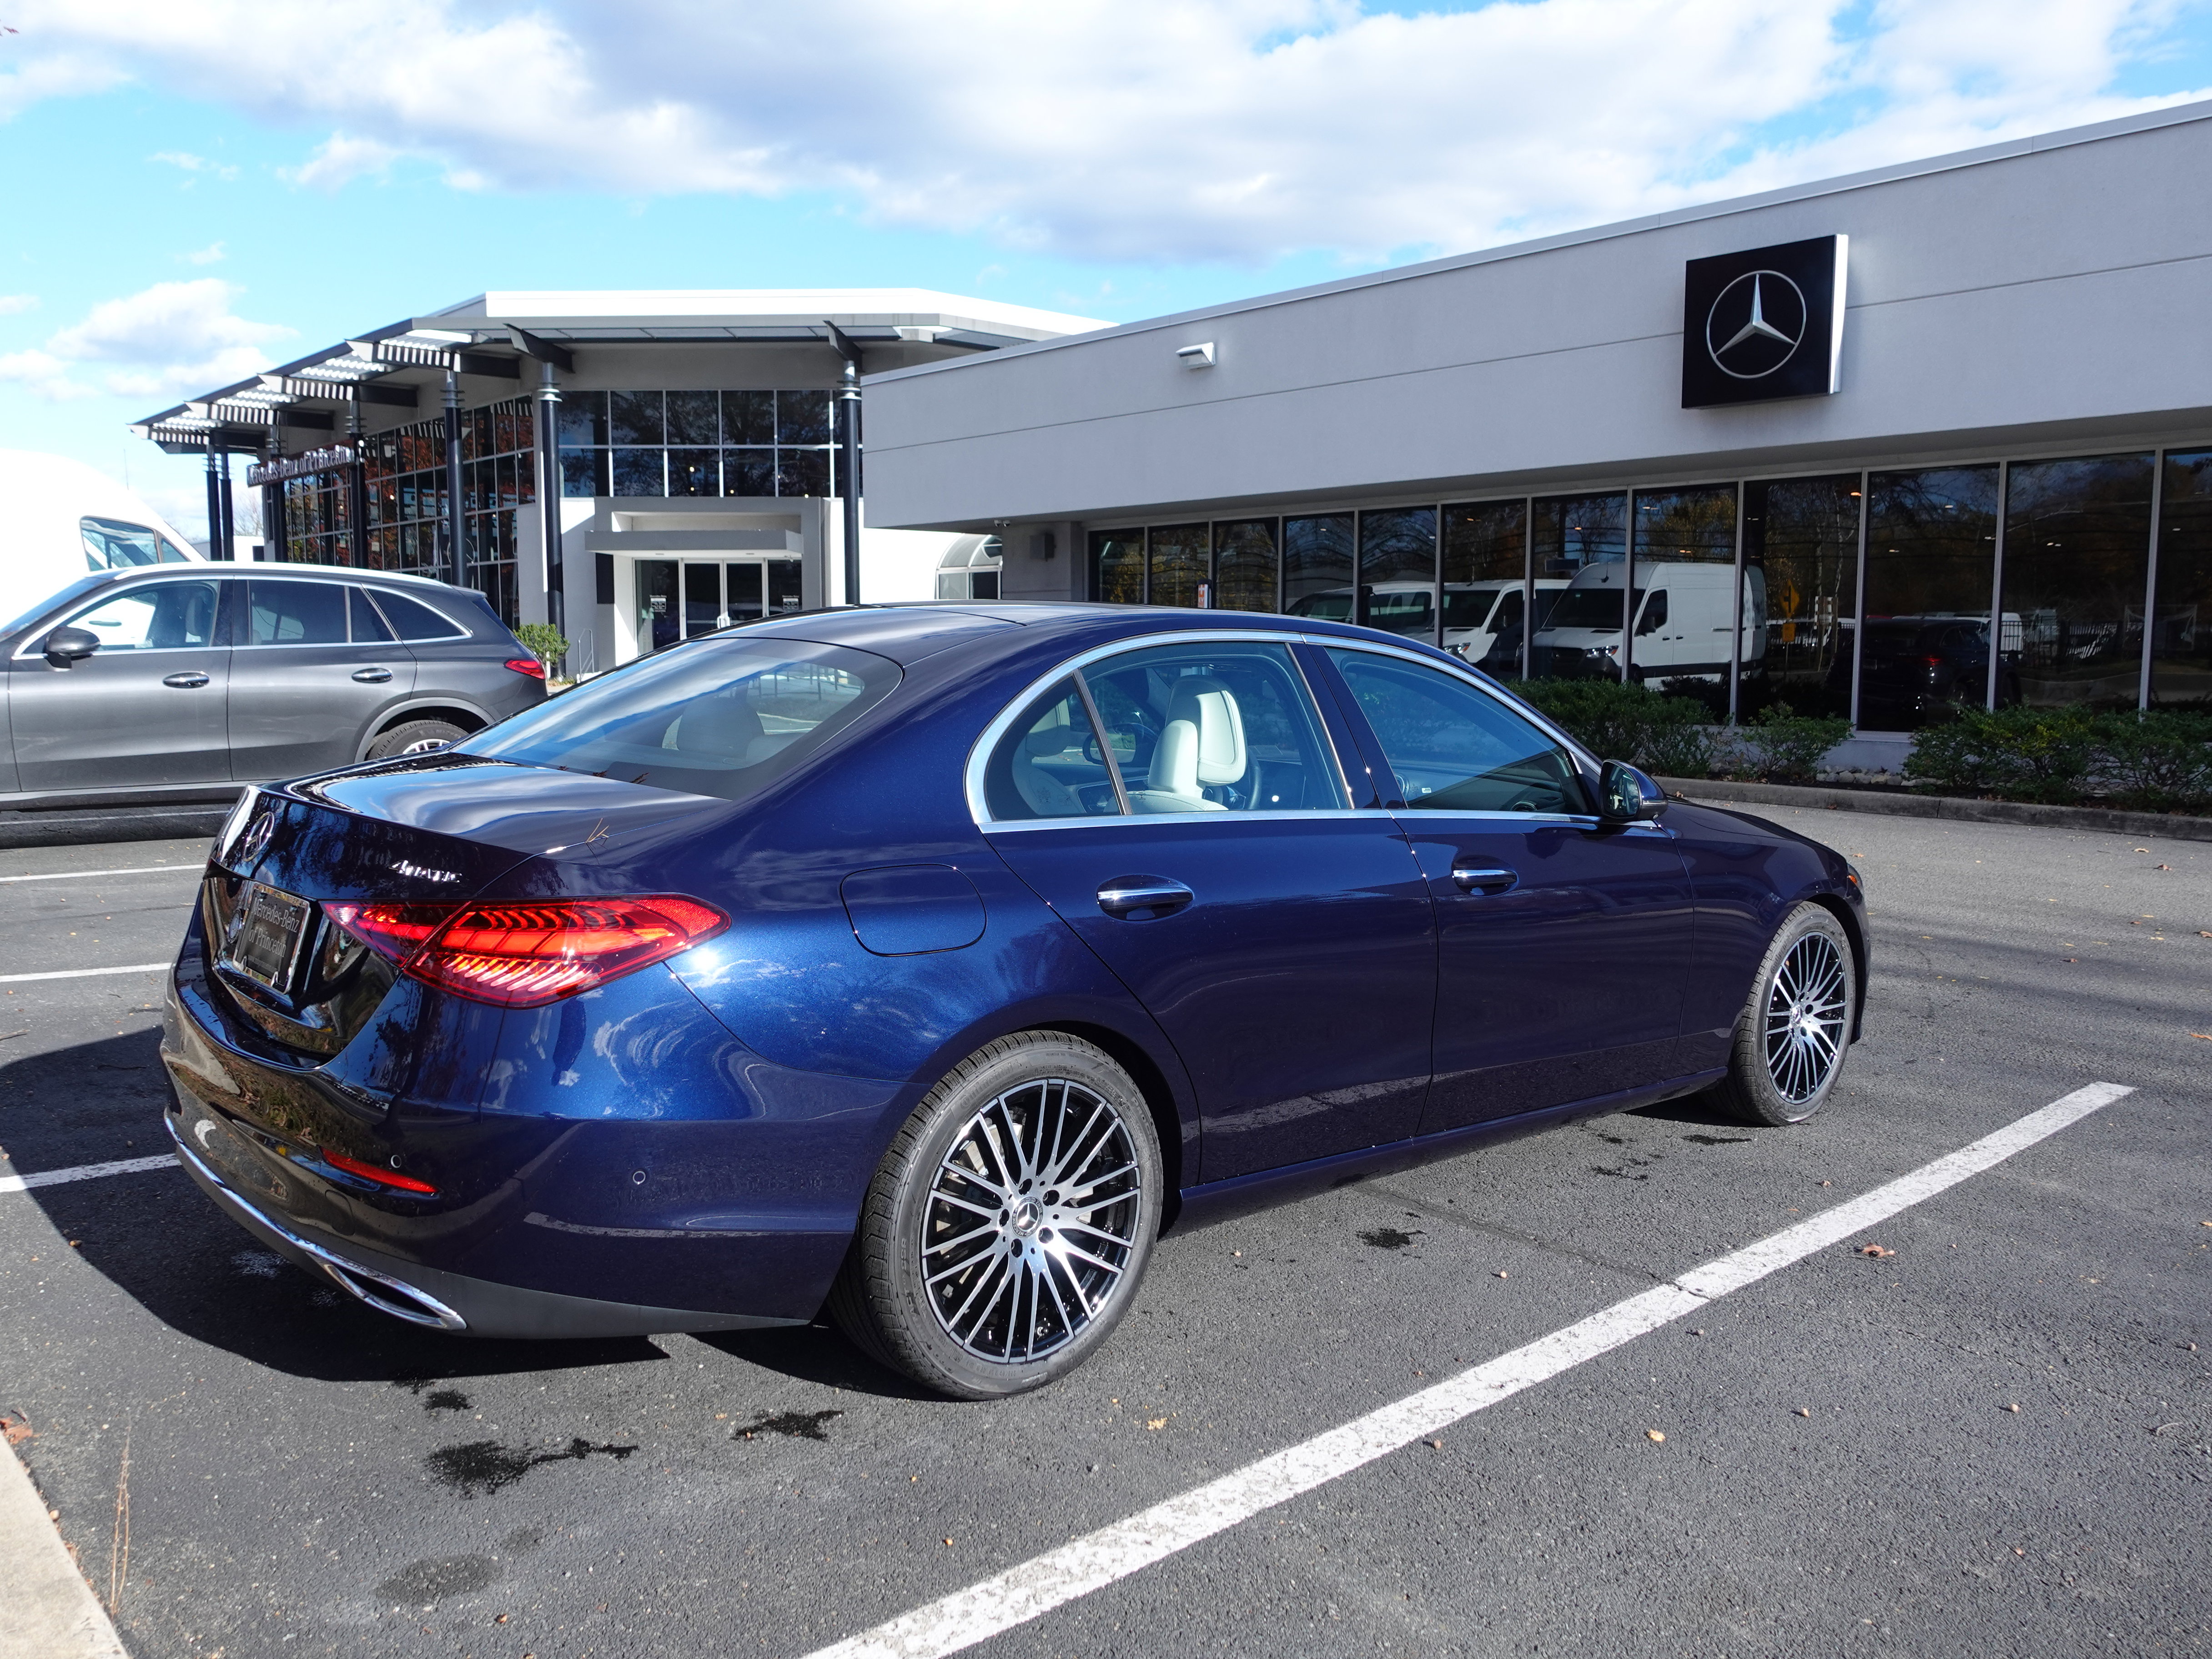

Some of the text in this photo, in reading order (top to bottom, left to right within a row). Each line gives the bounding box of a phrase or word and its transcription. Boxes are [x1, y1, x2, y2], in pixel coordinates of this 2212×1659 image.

[388, 860, 462, 883] 4MATIC
[251, 896, 300, 933] Mercedes-Benz
[249, 926, 287, 958] of Princeton
[1012, 1213, 1025, 1236] MERCEDES
